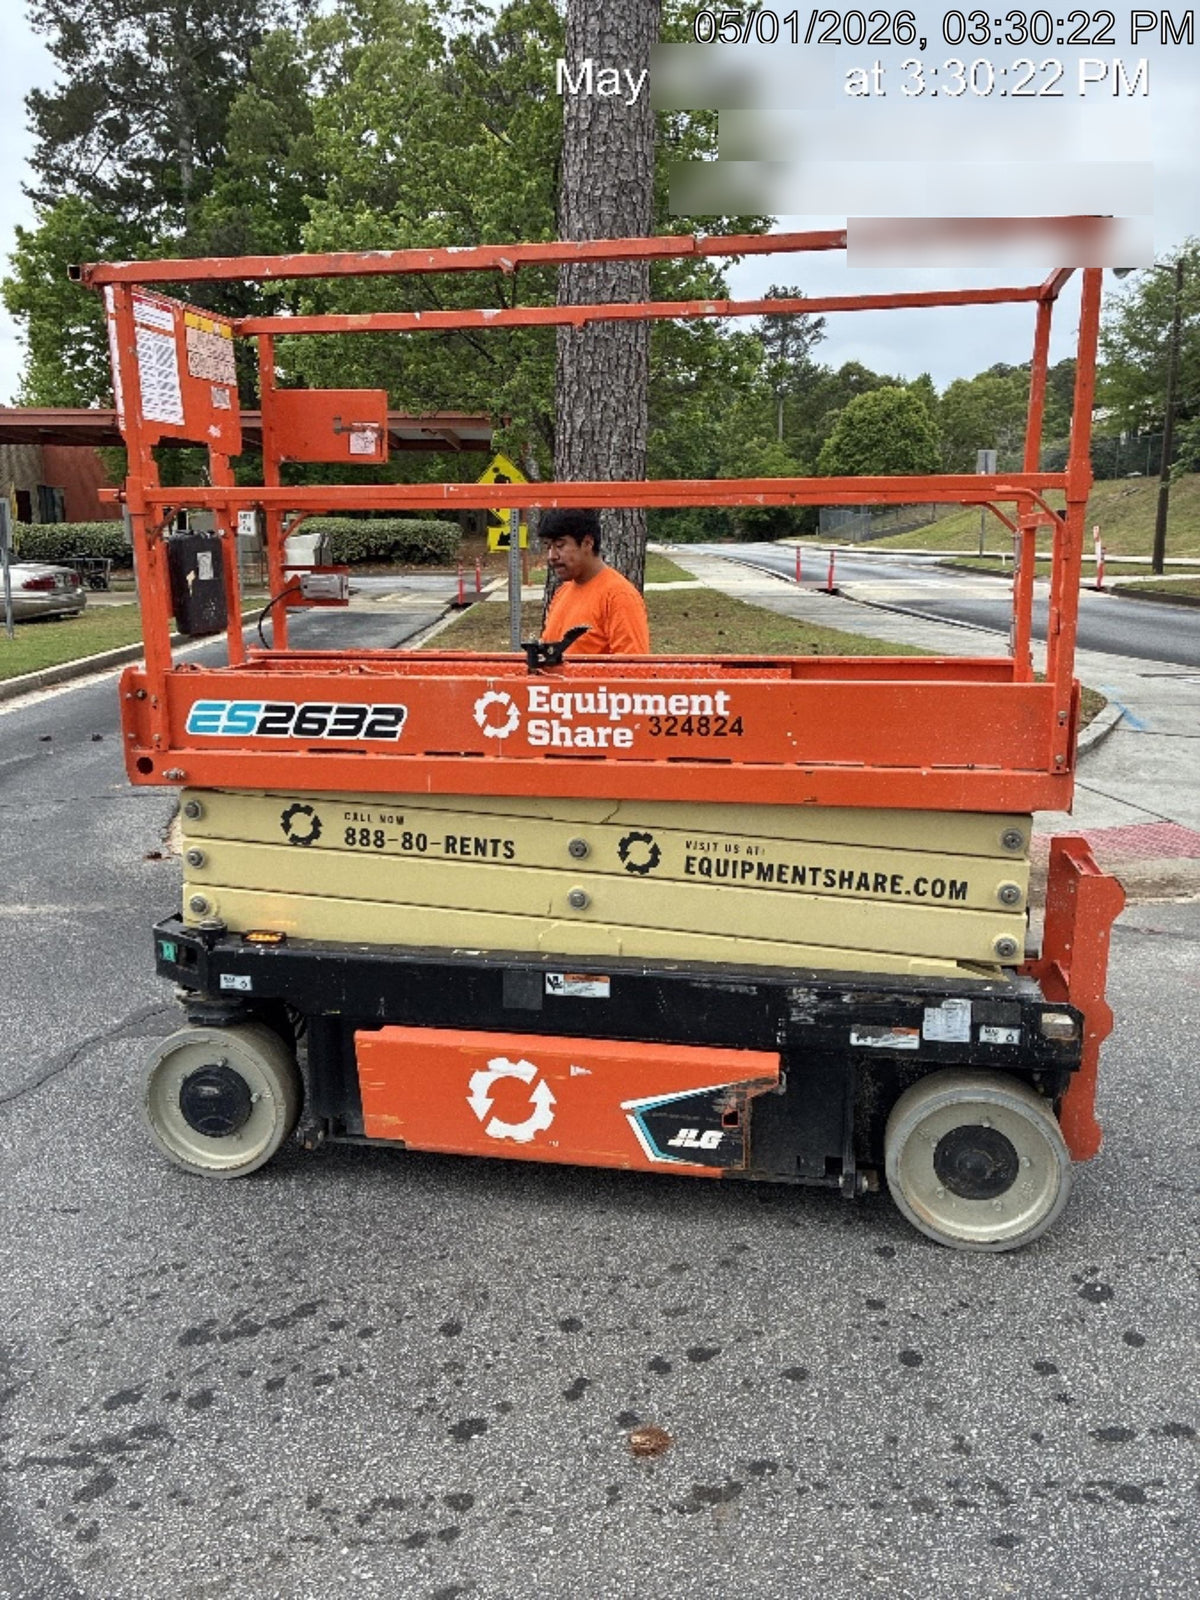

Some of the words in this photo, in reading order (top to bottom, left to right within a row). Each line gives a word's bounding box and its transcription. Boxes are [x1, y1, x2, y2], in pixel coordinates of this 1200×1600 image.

[527, 685, 731, 717] Equipment
[186, 700, 407, 742] ES2632
[527, 719, 633, 748] Share
[648, 715, 744, 737] 324824
[344, 812, 373, 823] CALL
[380, 815, 405, 826] NOW
[344, 827, 515, 859] 888-80-RENTS
[685, 840, 719, 852] VISIT
[724, 844, 740, 854] US
[684, 855, 969, 900] EQUIPMENTSHARE.COM
[667, 1128, 724, 1149] JLG
